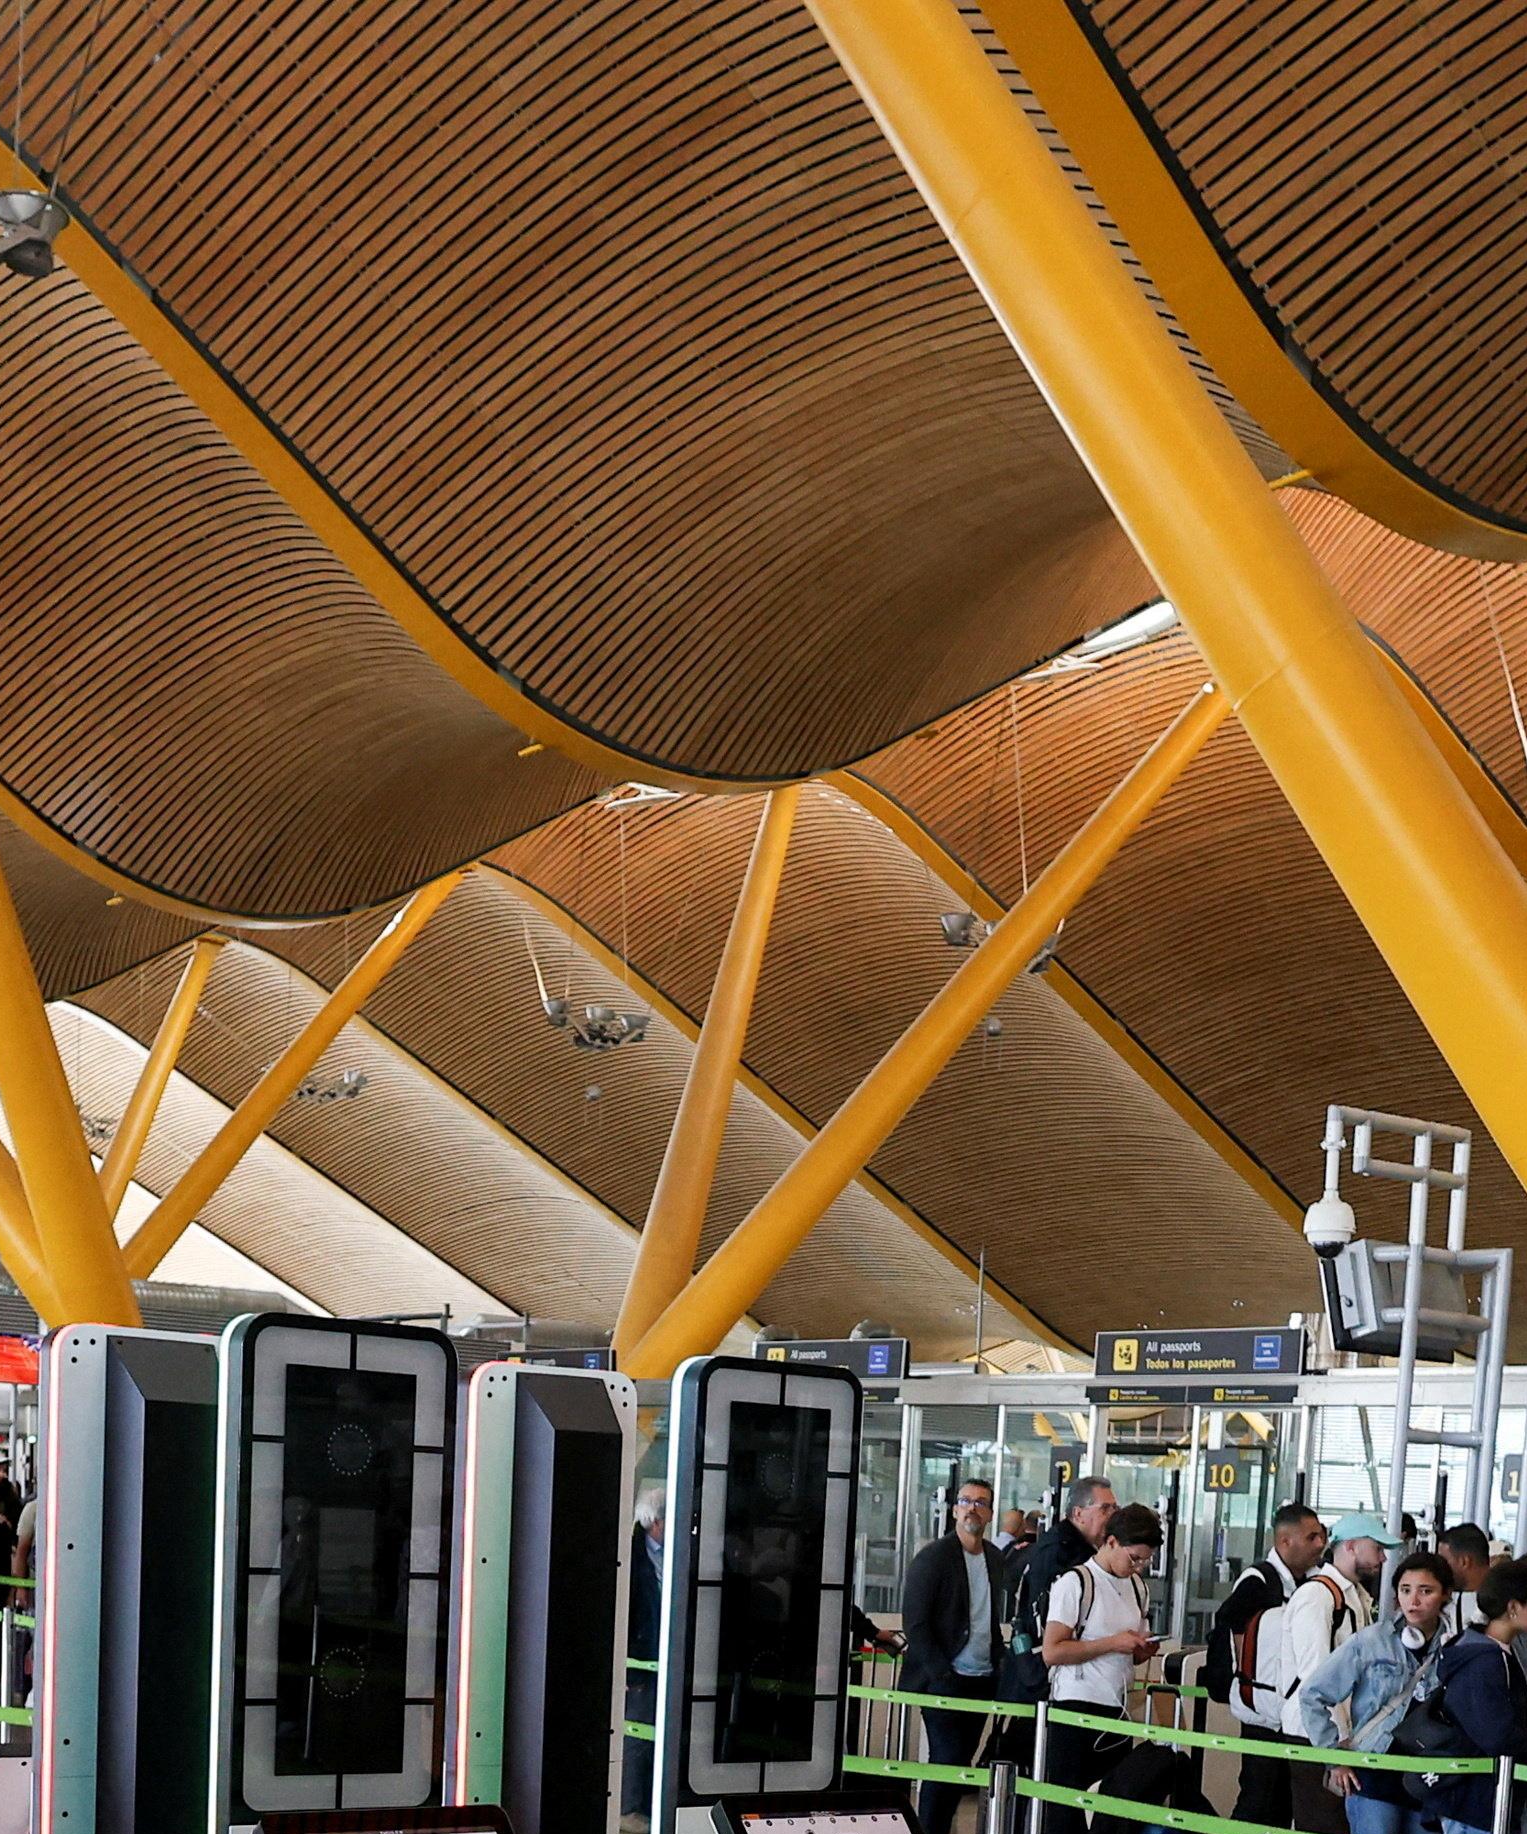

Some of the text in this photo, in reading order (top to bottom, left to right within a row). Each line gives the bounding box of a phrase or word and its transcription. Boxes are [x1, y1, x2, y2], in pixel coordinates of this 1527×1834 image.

[1146, 1341, 1202, 1354] All passports
[1145, 1357, 1237, 1372] Todos los pasaportes
[1209, 1463, 1235, 1488] 10
